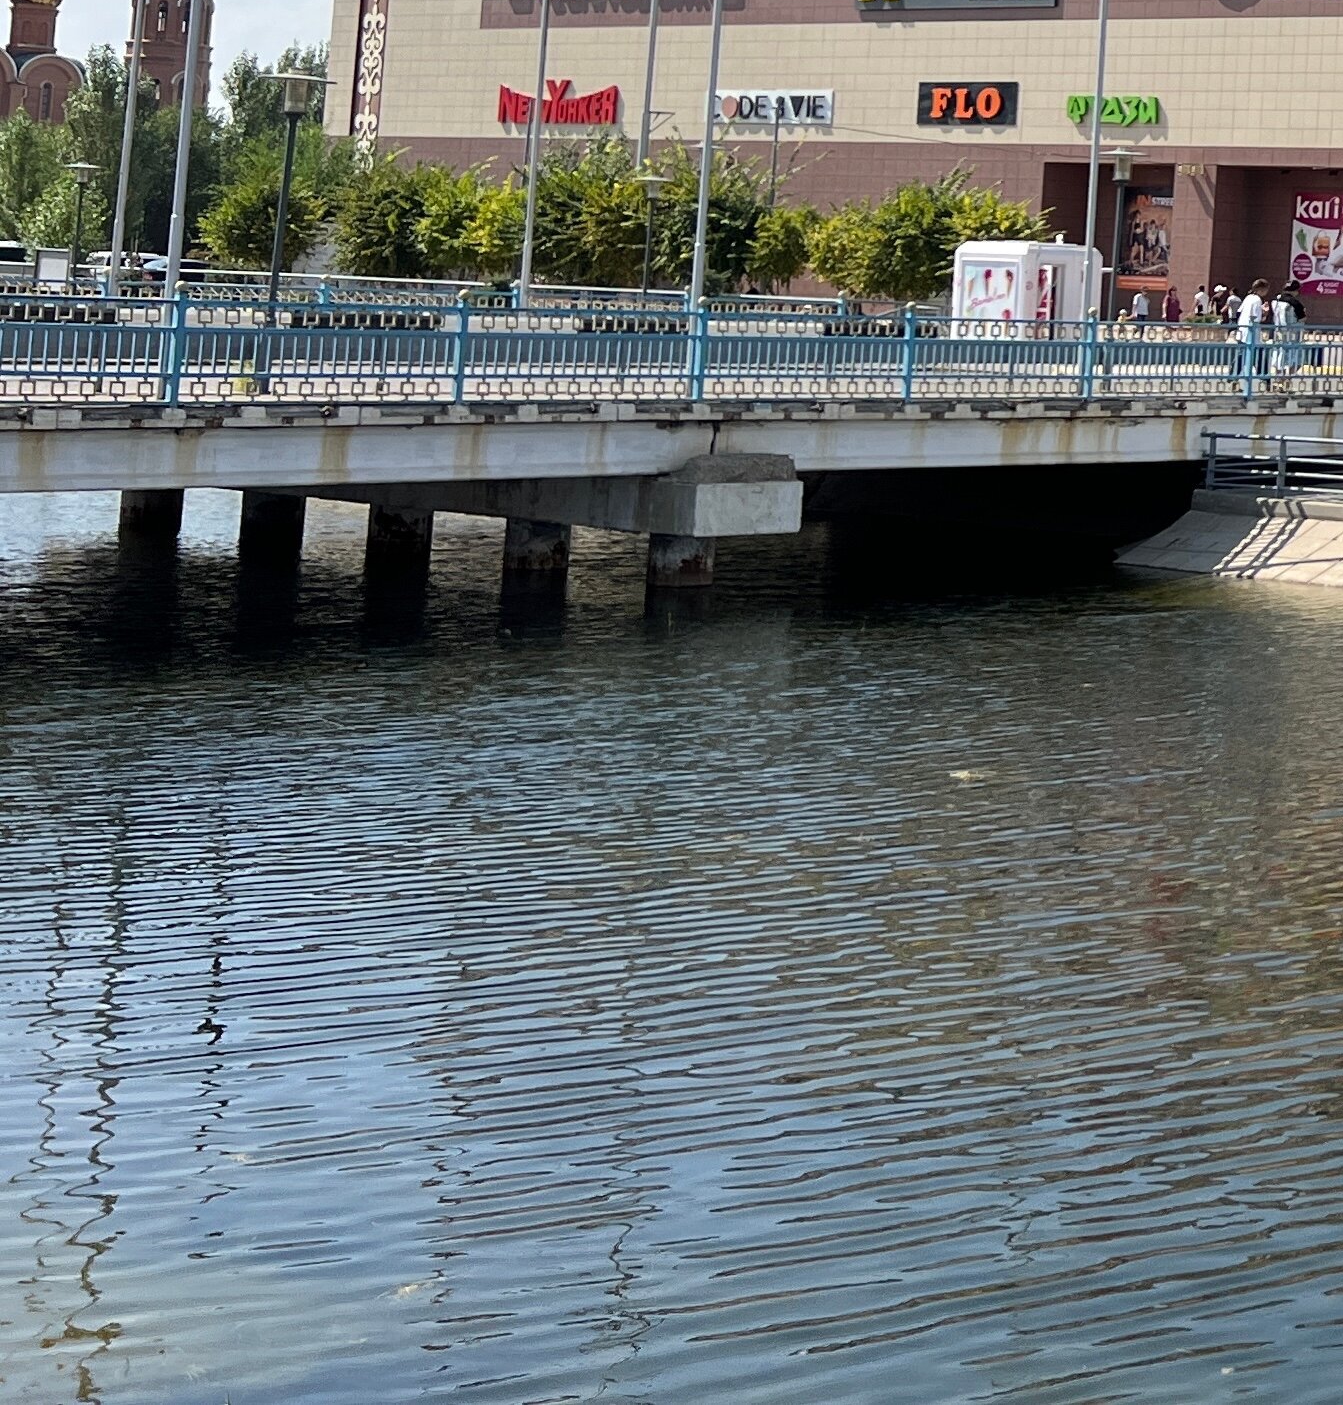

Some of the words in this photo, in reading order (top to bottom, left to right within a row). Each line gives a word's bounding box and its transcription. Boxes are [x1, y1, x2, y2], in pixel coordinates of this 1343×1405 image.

[930, 87, 1002, 119] FLO
[1067, 95, 1159, 126] ФДЗИ
[1296, 196, 1340, 219] kari
